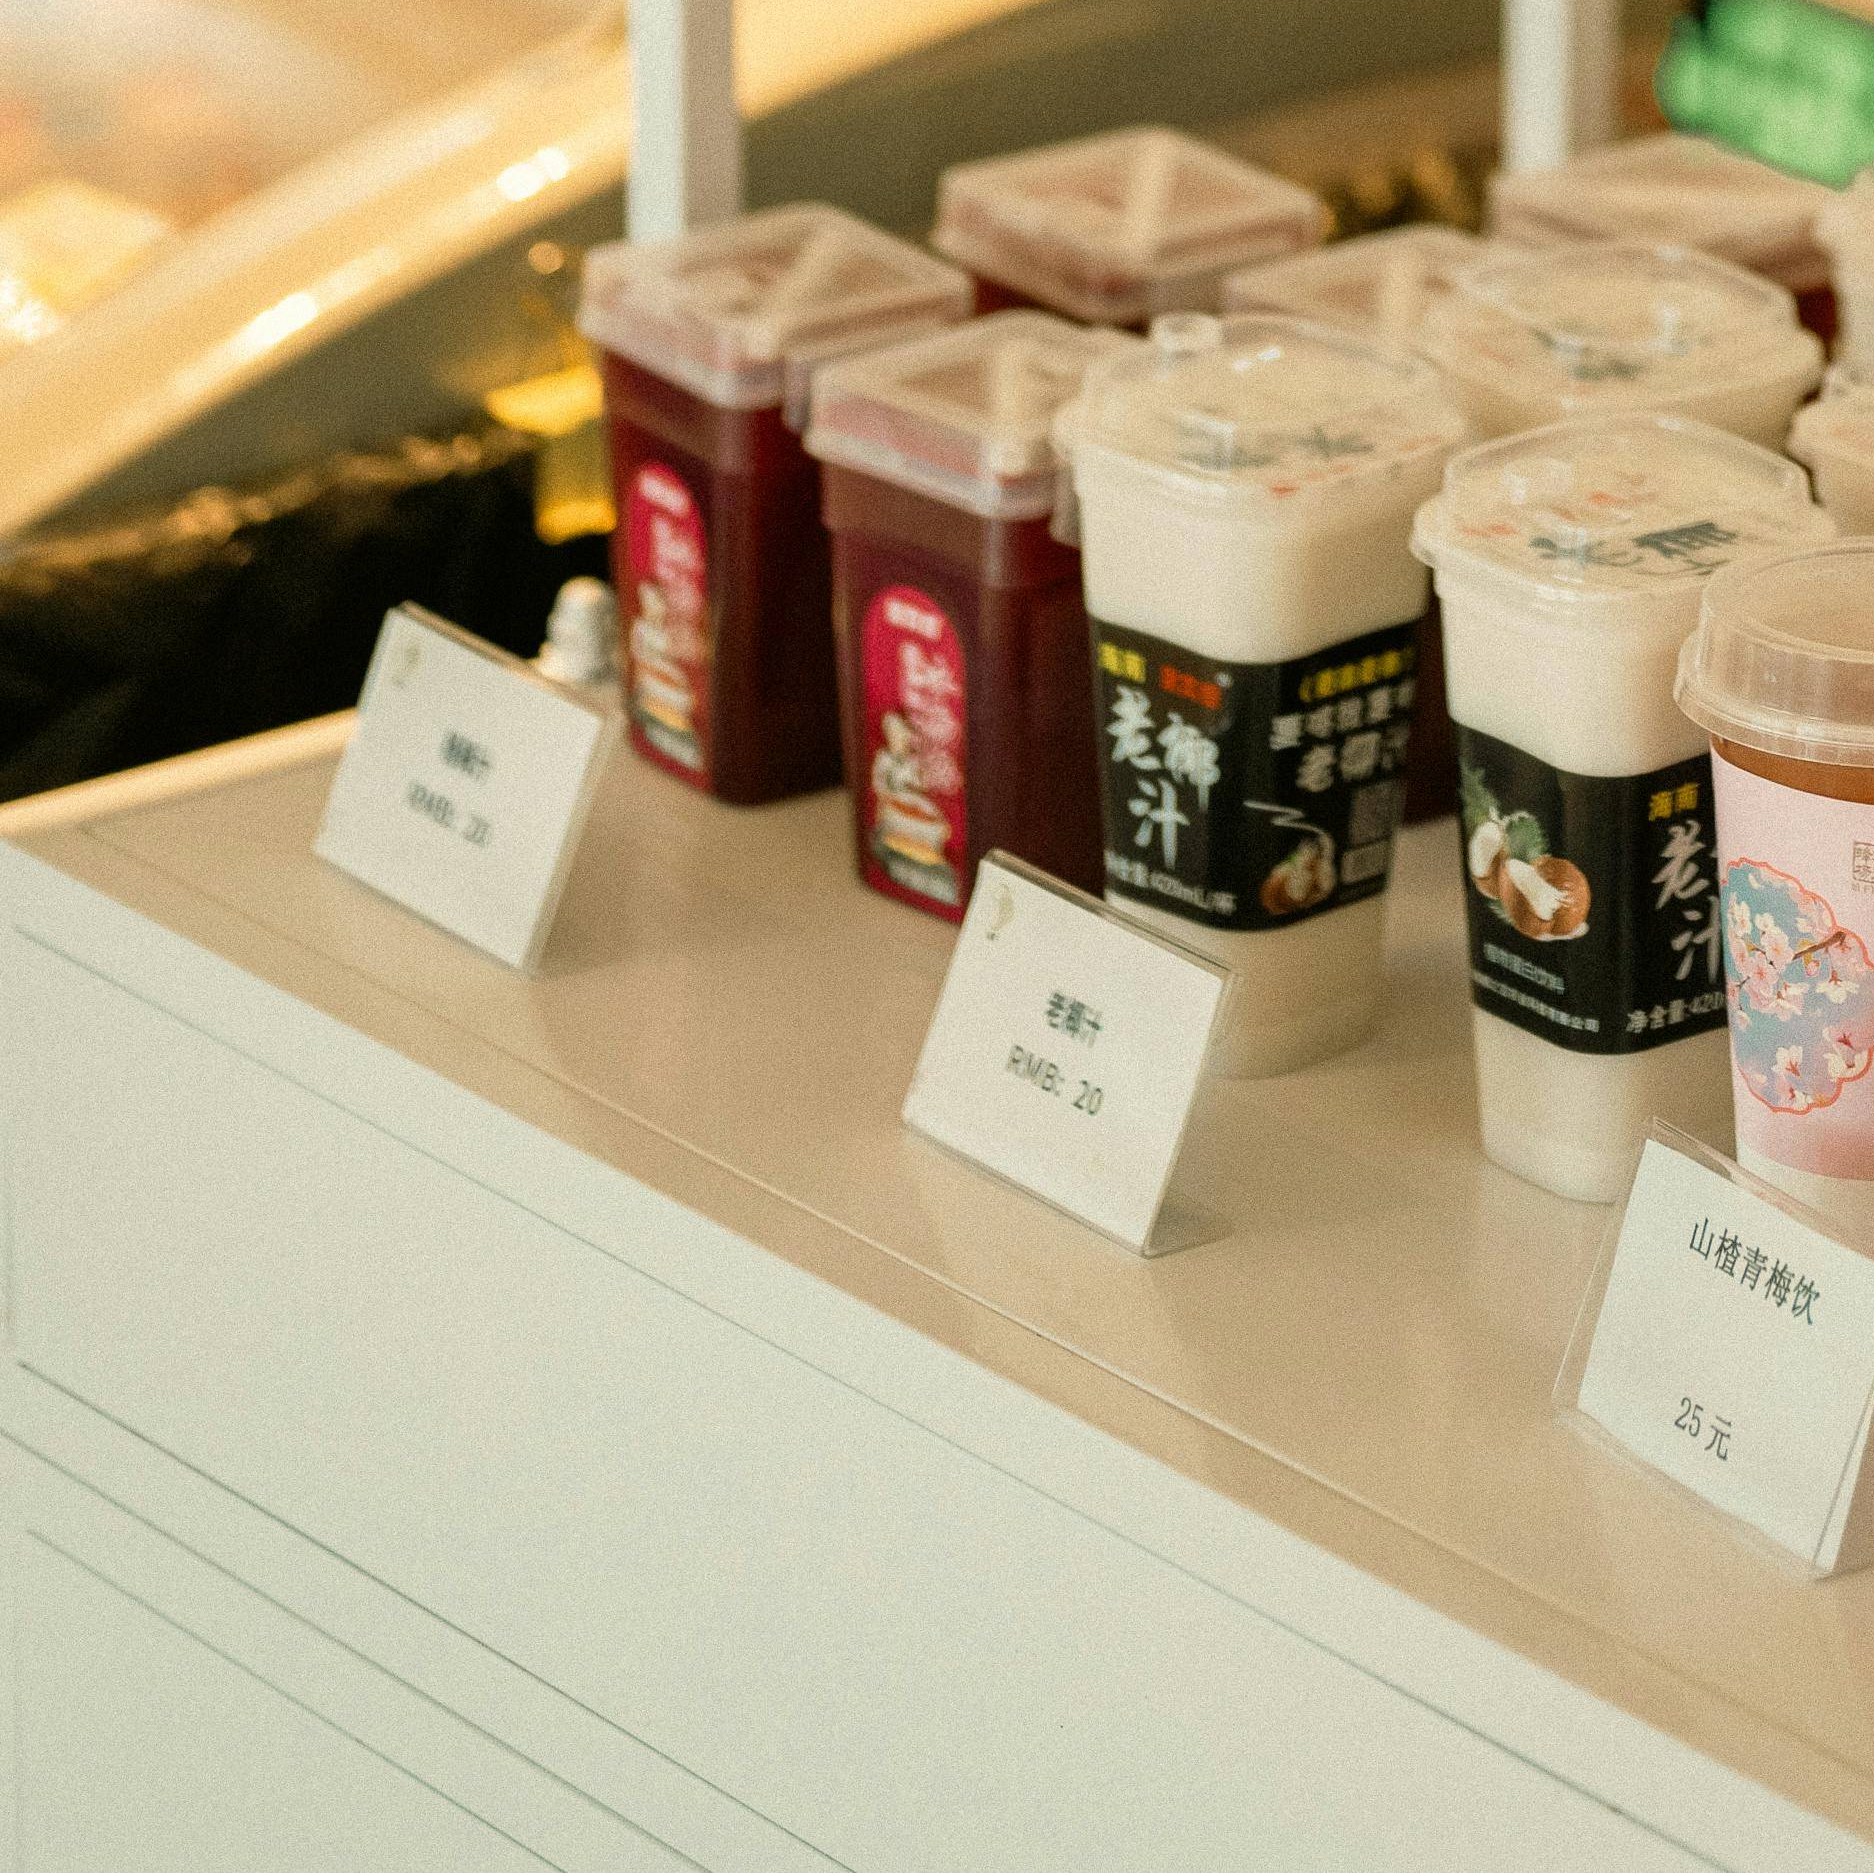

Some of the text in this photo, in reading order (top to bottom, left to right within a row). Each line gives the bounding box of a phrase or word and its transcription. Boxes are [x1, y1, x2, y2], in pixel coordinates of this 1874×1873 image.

[1651, 819, 1721, 985] 老汁
[1007, 1044, 1104, 1115] RMB: 20
[1689, 1216, 1821, 1326] 山楂青梅饮
[1673, 1396, 1735, 1462] 25 元
